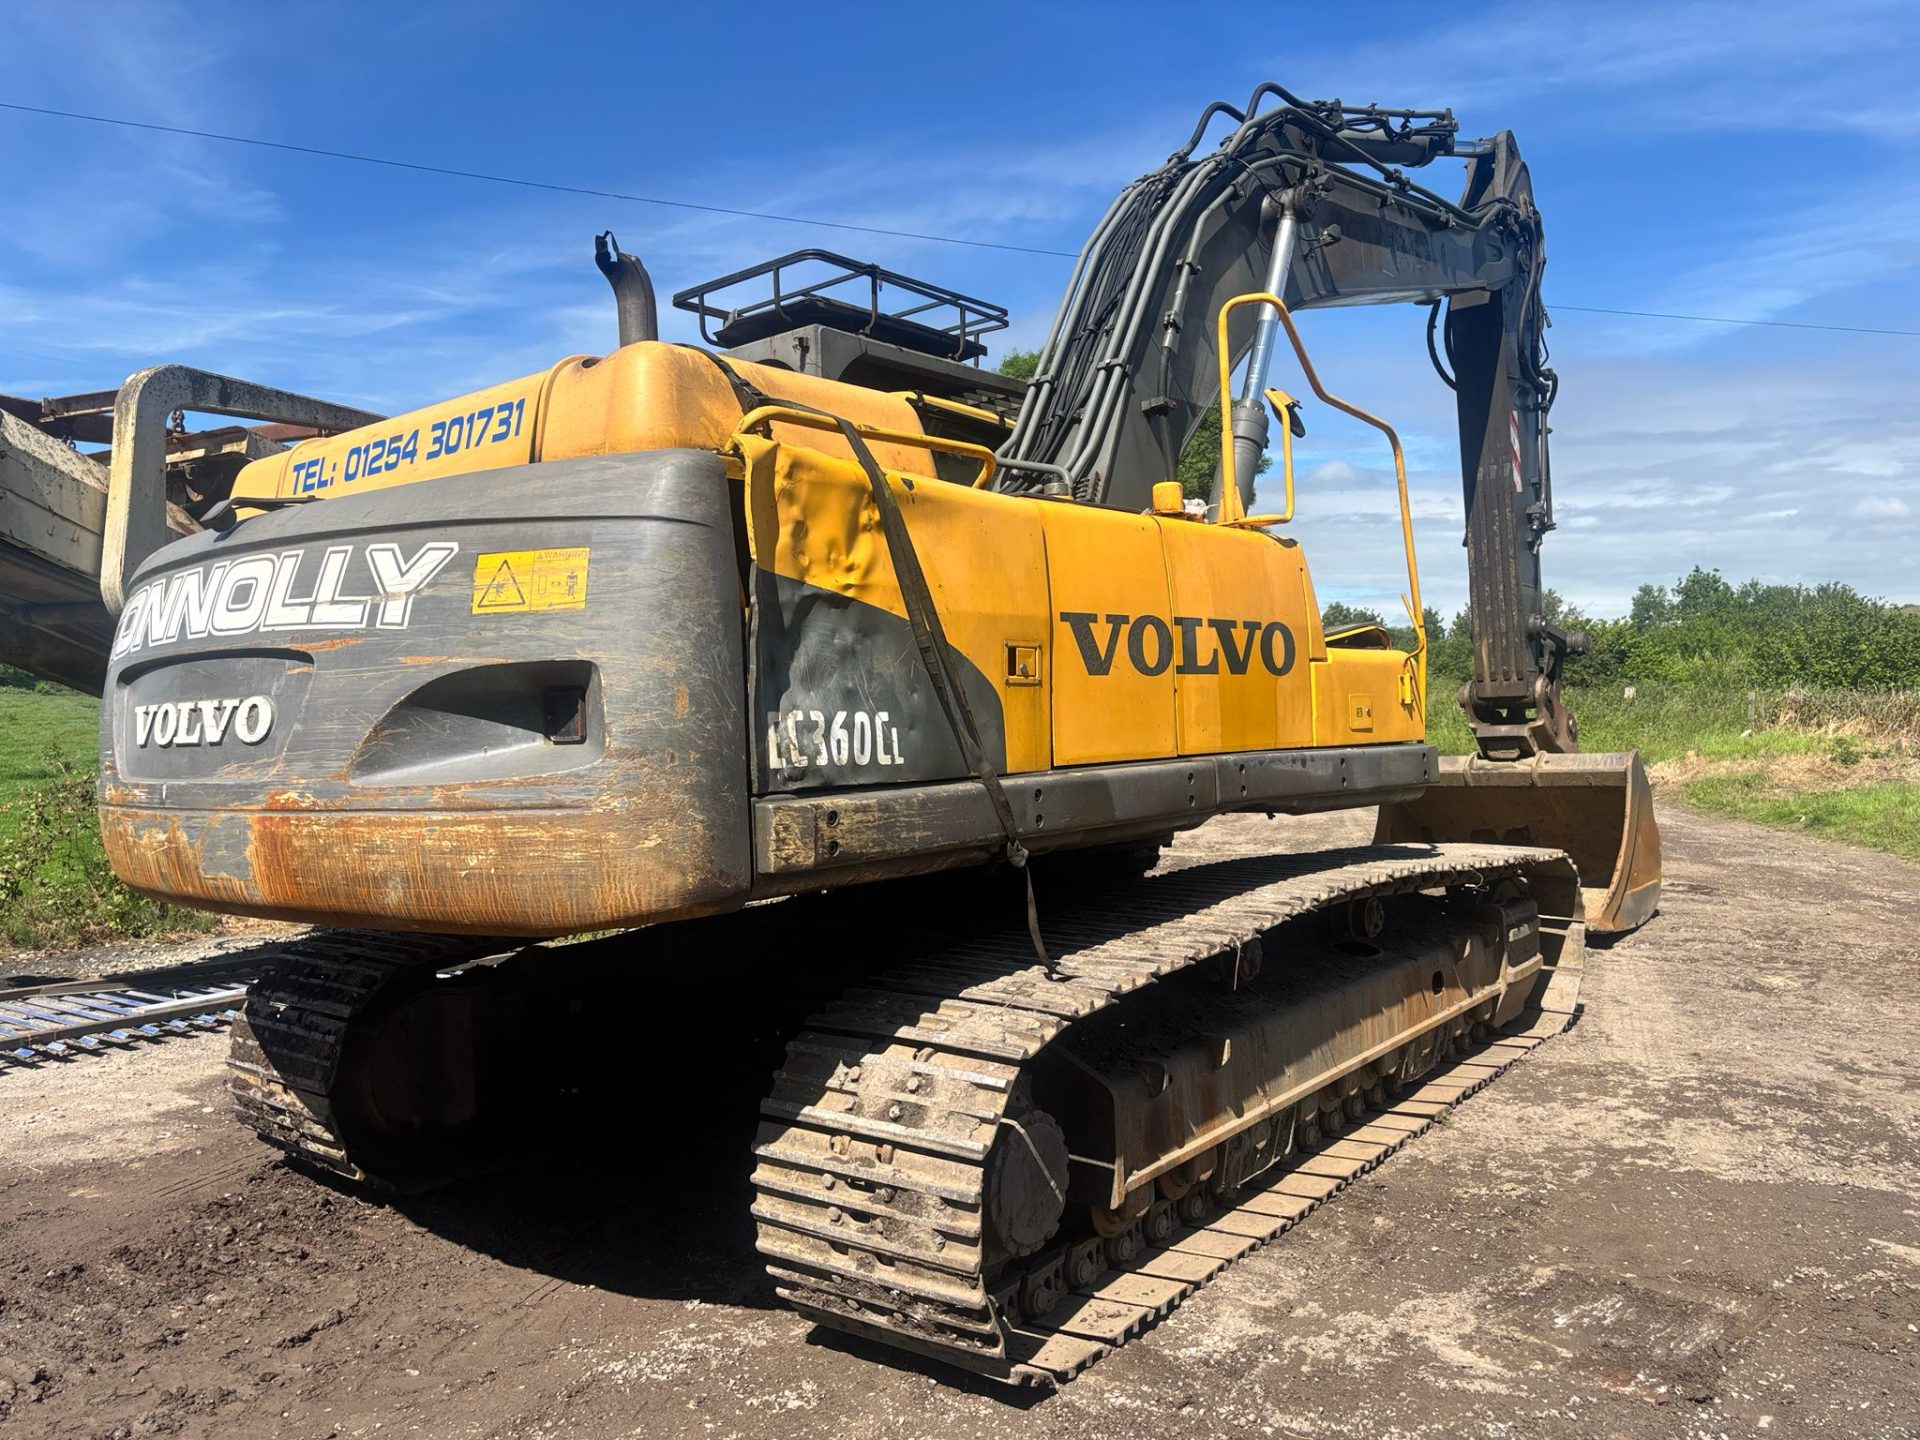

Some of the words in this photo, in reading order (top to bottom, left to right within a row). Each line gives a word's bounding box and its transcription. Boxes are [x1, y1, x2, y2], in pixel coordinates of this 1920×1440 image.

[293, 457, 336, 495] TEL:
[344, 429, 420, 482] 01254
[426, 397, 526, 461] 301731
[112, 541, 459, 662] ONNOLLY
[1060, 612, 1296, 676] VOLVO
[134, 695, 276, 748] VOLVO
